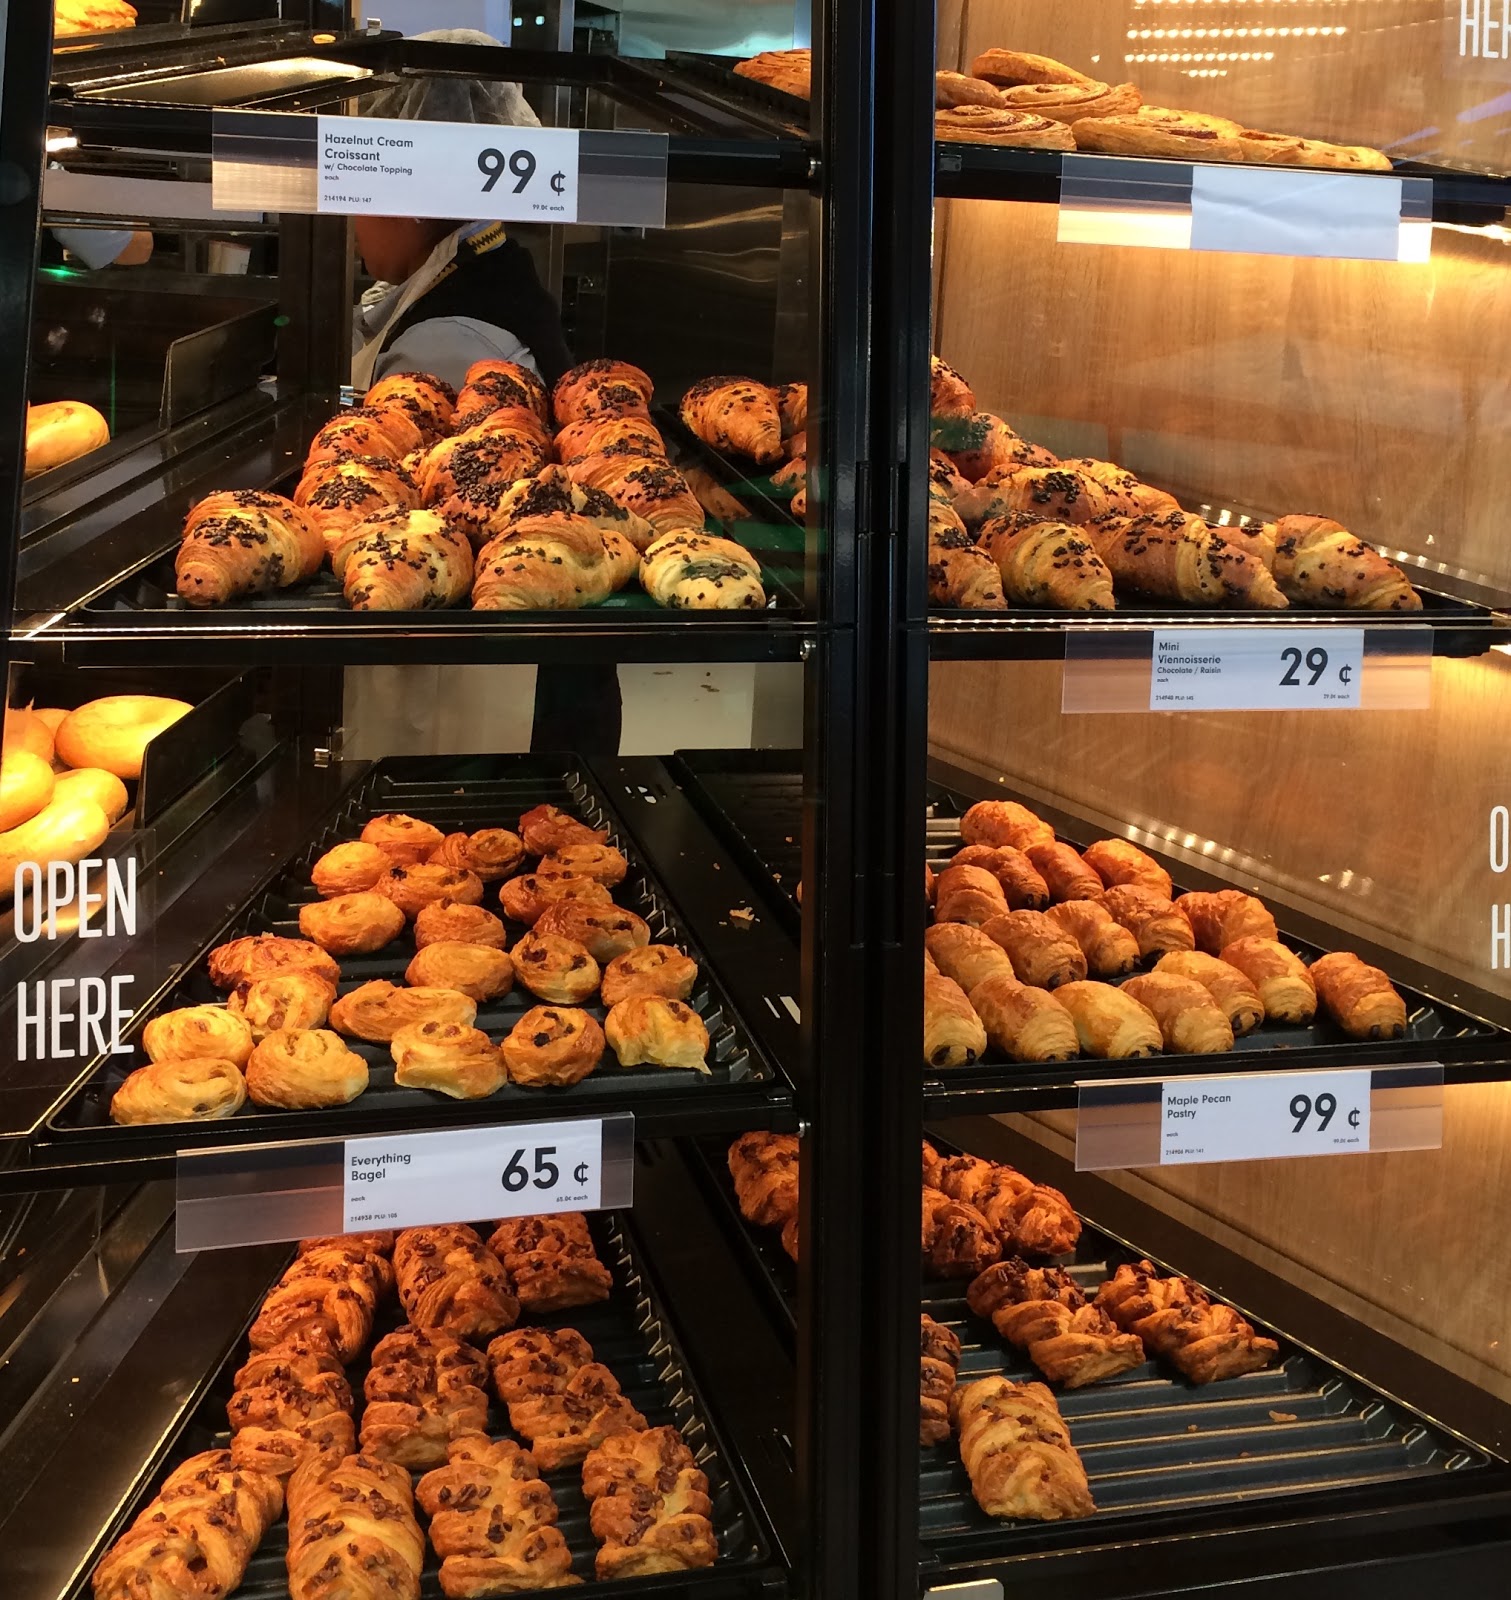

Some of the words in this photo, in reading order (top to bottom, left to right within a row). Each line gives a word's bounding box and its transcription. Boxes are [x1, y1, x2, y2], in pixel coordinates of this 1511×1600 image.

[324, 133, 374, 146] Hazelnut
[377, 135, 414, 148] Cream
[324, 148, 381, 161] Croissant
[324, 163, 335, 171] w/
[337, 162, 378, 172] Chocolate
[380, 165, 413, 176] Topping
[477, 147, 537, 194] 99
[550, 170, 566, 196] ¢
[1159, 641, 1180, 651] Mini
[1158, 654, 1221, 665] Viennoisserie
[1279, 647, 1329, 686] 29
[1338, 664, 1352, 686] ¢
[1157, 666, 1193, 674] Chocolate
[1200, 666, 1222, 674] Raisin
[14, 857, 137, 943] OPEN
[17, 974, 135, 1062] HERE
[1167, 1095, 1199, 1107] Maple
[1202, 1093, 1232, 1104] Pecan
[1167, 1108, 1196, 1120] Pastry
[1289, 1092, 1337, 1133] 99
[1347, 1107, 1361, 1130] ¢
[351, 1152, 412, 1168] Everything
[351, 1168, 386, 1182] Bagel
[501, 1146, 560, 1192] 65
[573, 1162, 589, 1186] ¢
